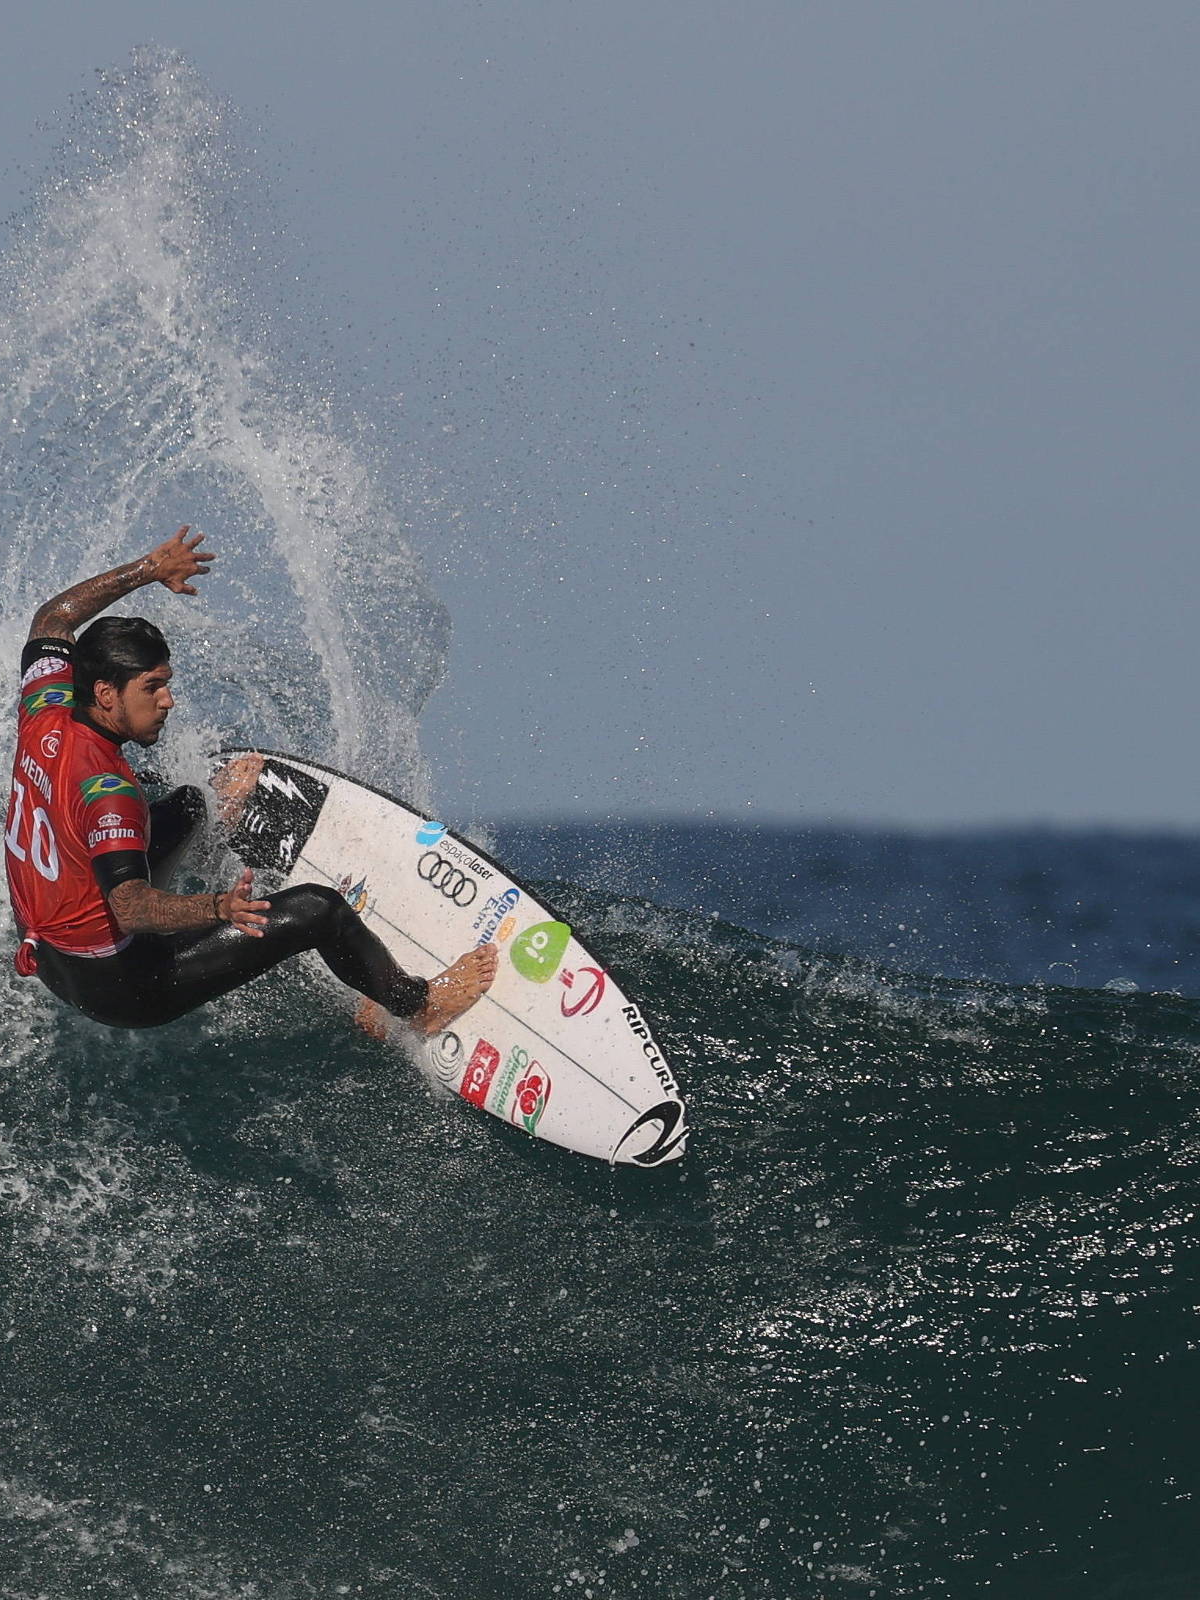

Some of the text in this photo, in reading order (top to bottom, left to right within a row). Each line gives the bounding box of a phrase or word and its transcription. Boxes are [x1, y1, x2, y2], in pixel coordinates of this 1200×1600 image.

[19, 749, 53, 804] MEDINA
[5, 777, 60, 882] 10
[88, 828, 136, 849] Corona
[440, 839, 495, 881] espaçolaser
[468, 1055, 493, 1094] TCL
